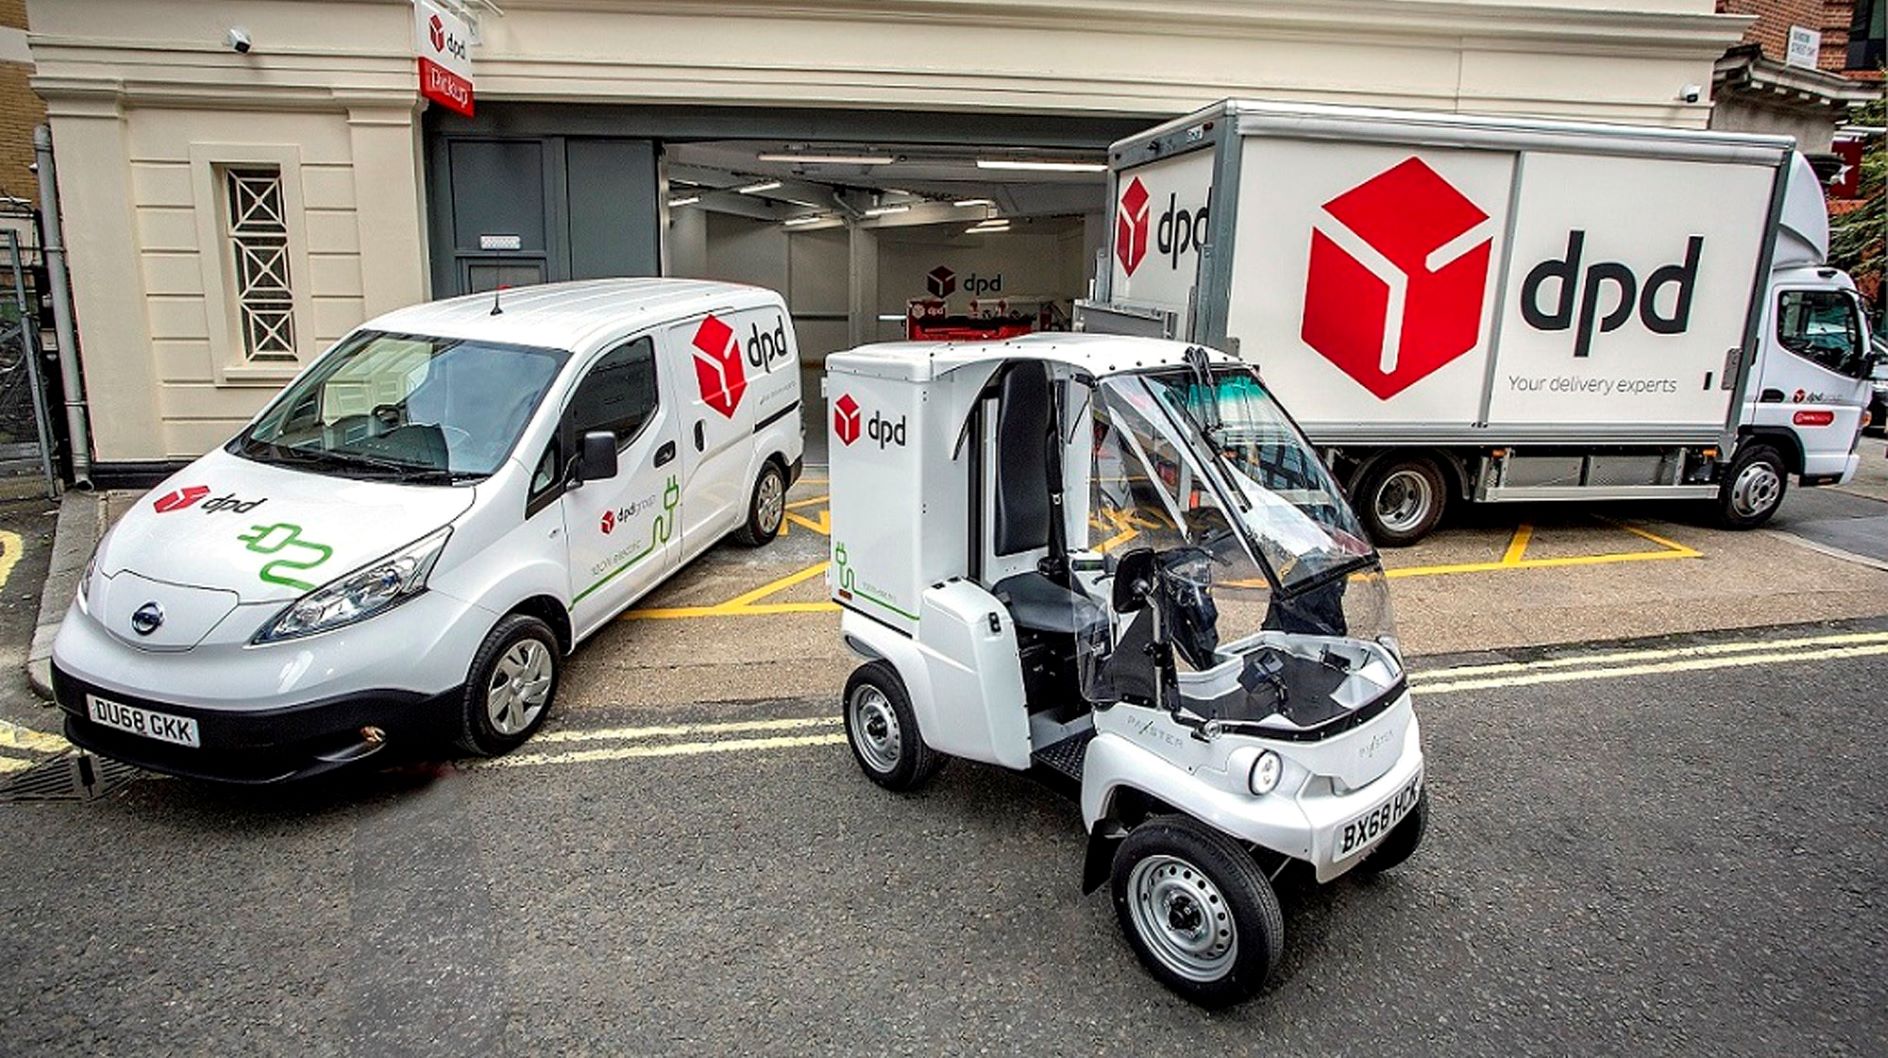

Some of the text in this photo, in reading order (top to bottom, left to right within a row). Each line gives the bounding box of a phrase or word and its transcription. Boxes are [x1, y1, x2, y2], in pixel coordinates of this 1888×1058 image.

[1158, 186, 1212, 270] dpd
[963, 272, 1002, 296] dpd
[1521, 230, 1704, 357] dpd
[747, 314, 788, 374] dpd
[1508, 375, 1678, 396] Your delivery experts
[868, 410, 906, 450] dpd
[201, 492, 268, 514] dpd
[95, 699, 192, 742] DU68 GKK
[1342, 776, 1419, 854] BX68 HCK
